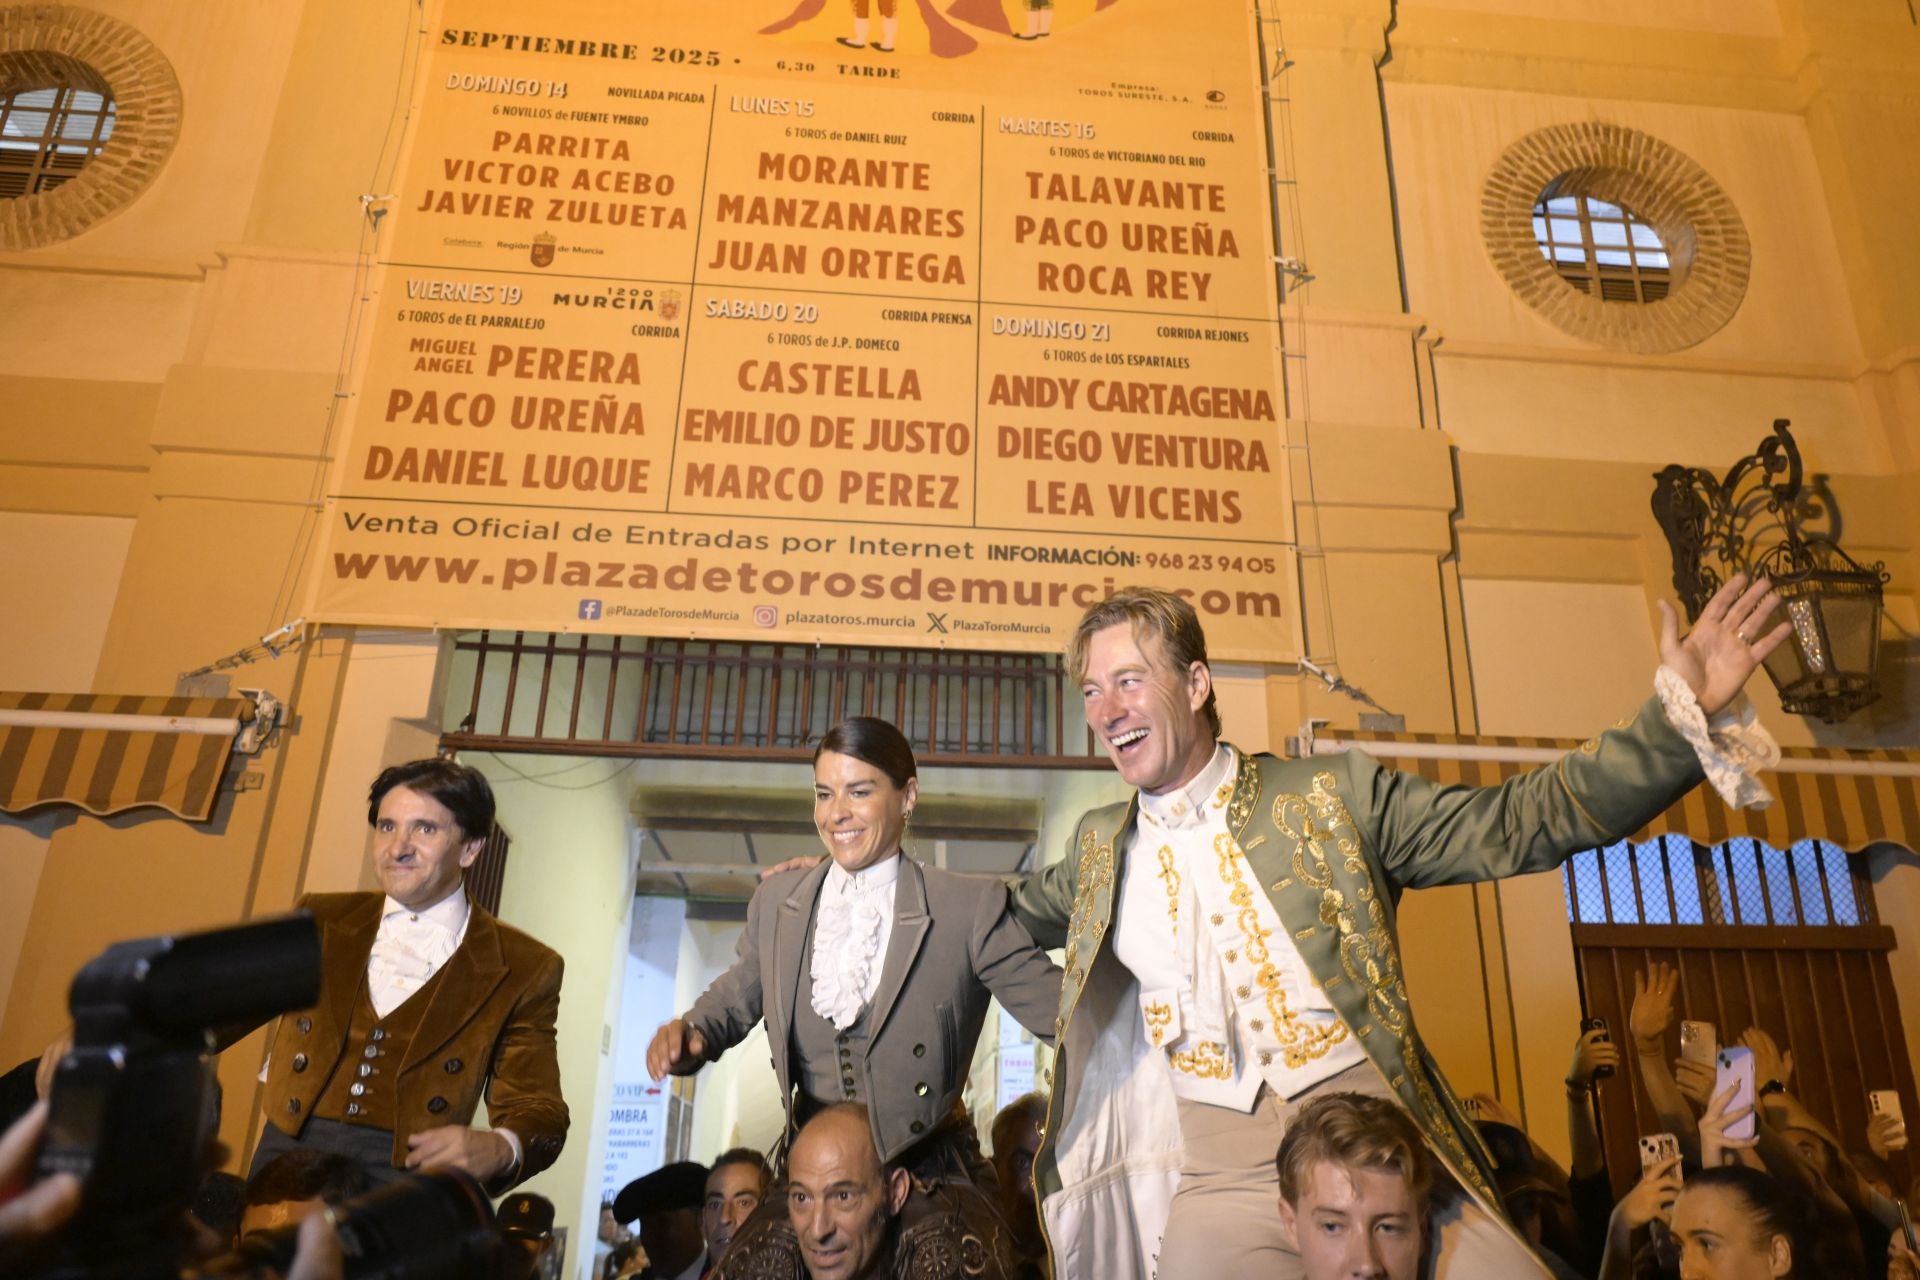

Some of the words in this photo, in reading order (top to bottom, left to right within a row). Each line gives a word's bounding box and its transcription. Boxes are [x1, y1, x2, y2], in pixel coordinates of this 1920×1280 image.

[442, 29, 638, 60] SEPTIEMBRE
[652, 46, 721, 67] 2025
[837, 64, 901, 79] TARDE
[446, 73, 541, 97] DOMINGO
[545, 80, 568, 99] 14
[608, 87, 665, 102] NOVILLADA
[667, 91, 705, 104] PICADA
[1078, 88, 1114, 97] TOROS
[492, 105, 500, 116] 6
[502, 105, 552, 121] NOVILLOS
[555, 109, 568, 121] de
[570, 111, 608, 125] FUENTE
[612, 113, 649, 127] YMBRO
[731, 96, 790, 116] LUNES
[795, 100, 815, 118] 15
[932, 111, 975, 125] CORRIDA
[785, 126, 792, 138] 6
[795, 127, 827, 140] TOROS
[830, 130, 843, 141] de
[845, 131, 881, 144] DANIEL
[884, 134, 907, 145] RUIZ
[999, 117, 1070, 138] MARTES
[1074, 121, 1096, 140] 16
[1192, 130, 1235, 144] CORRIDA
[492, 130, 631, 162] PARRITA
[1049, 146, 1056, 157] 6
[1058, 147, 1090, 160] TOROS
[1092, 149, 1105, 161] de
[1107, 150, 1166, 165] VICTORIANO
[1168, 154, 1186, 166] DEL
[1189, 155, 1206, 167] RIO
[443, 158, 559, 189] VICTOR
[571, 170, 676, 197] ACEBO
[758, 152, 931, 191] MORANTE
[1025, 171, 1227, 213] TALAVANTE
[417, 189, 533, 221] JAVIER
[546, 198, 688, 230] ZULUETA
[716, 193, 965, 238] MANZANARES
[497, 241, 530, 250] Región
[572, 246, 604, 255] Murcia
[1015, 215, 1108, 250] PACO
[1122, 222, 1240, 259] UREÑA
[709, 239, 807, 275] JUAN
[821, 245, 966, 285] ORTEGA
[407, 280, 496, 303] VIERNES
[500, 285, 522, 306] 19
[607, 287, 654, 299] 1200
[1037, 262, 1133, 297] ROCA
[1146, 270, 1212, 302] REY
[553, 293, 654, 312] MURCIA
[705, 298, 788, 321] SABADO
[793, 303, 819, 323] 20
[398, 311, 405, 322] 6
[408, 312, 445, 325] TOROS
[448, 314, 463, 326] de
[465, 315, 478, 327] EL
[481, 316, 545, 331] PARRALEJO
[882, 308, 928, 323] CORRIDA
[931, 312, 972, 325] PRENSA
[992, 316, 1086, 340] DOMINGO
[1091, 323, 1110, 341] 21
[632, 324, 680, 339] CORRIDA
[767, 332, 774, 344] 6
[777, 333, 812, 347] TOROS
[815, 336, 829, 347] de
[831, 337, 852, 349] J.P.
[856, 338, 900, 351] DOMECQ
[1157, 326, 1202, 340] CORRIDA
[1204, 329, 1249, 343] REJONES
[409, 337, 477, 356] MIGUEL
[1043, 348, 1050, 361] 6
[1053, 349, 1086, 363] TOROS
[1089, 352, 1103, 363] de
[1105, 353, 1124, 365] LOS
[1127, 354, 1190, 369] ESPARTALES
[414, 356, 474, 375] ANGEL
[487, 344, 642, 386] PERERA
[738, 359, 922, 401] CASTELLA
[988, 374, 1080, 410] ANDY
[1087, 380, 1276, 422] CARTAGENA
[385, 388, 496, 428] PACO
[510, 394, 645, 436] UREÑA
[683, 408, 800, 448] EMILIO
[809, 415, 855, 450] DE
[862, 418, 970, 456] JUSTO
[998, 425, 1102, 464] DIEGO
[1111, 432, 1270, 473] VENTURA
[364, 445, 508, 487] DANIEL
[521, 453, 650, 494] LUQUE
[684, 462, 824, 503] MARCO
[839, 470, 960, 509] PEREZ
[1027, 480, 1094, 517] LEA
[1108, 484, 1242, 524] VICENS
[344, 512, 438, 535] Venta
[453, 517, 559, 541] Oficial
[573, 522, 612, 544] de
[626, 525, 769, 552] Entradas
[782, 535, 837, 556] por
[850, 535, 975, 561] Internet
[987, 544, 1141, 567] INFORMACIÓN:
[1146, 552, 1183, 570] 968
[1188, 554, 1213, 571] 23
[1218, 555, 1243, 573] 94
[334, 552, 1281, 618] www.plazadetorosdemurciom
[606, 605, 740, 622] @PlazadeTorosdeMurcia
[785, 611, 916, 629] plazatoros.murcia
[953, 619, 1051, 635] PlazaToroMurcia
[627, 1084, 645, 1097] VIP
